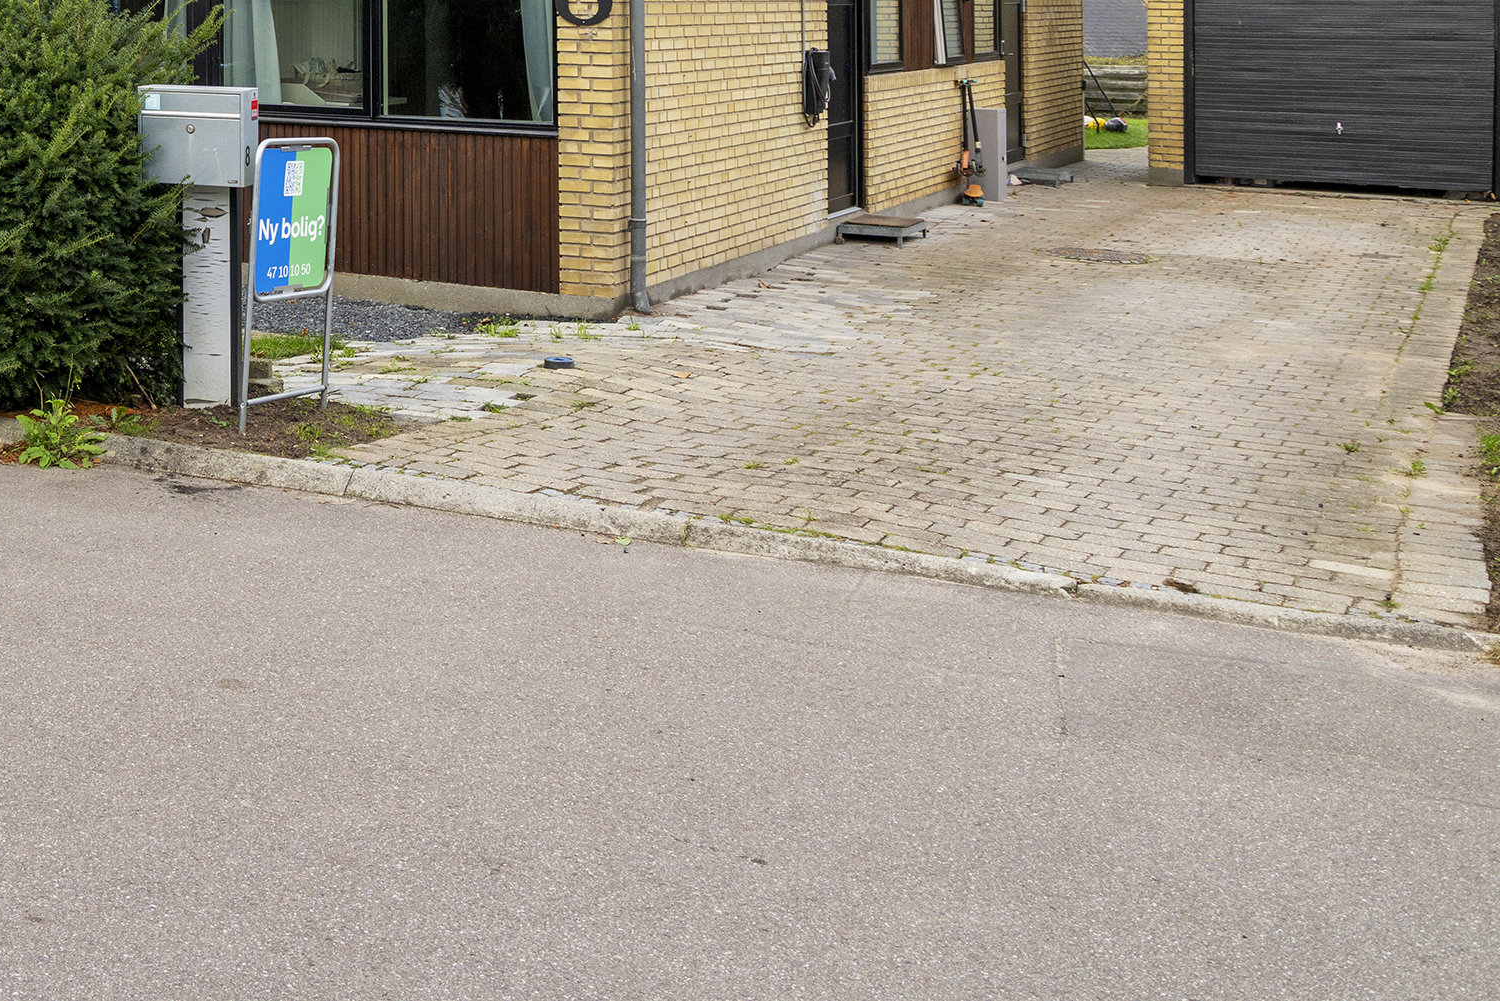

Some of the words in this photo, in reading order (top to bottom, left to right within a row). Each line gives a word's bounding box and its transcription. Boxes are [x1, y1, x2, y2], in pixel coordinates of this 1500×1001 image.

[245, 145, 251, 167] 8
[258, 218, 279, 246] Ny
[281, 214, 325, 242] bolig?
[266, 266, 278, 279] 47
[278, 265, 289, 278] 10
[290, 264, 300, 277] 10
[301, 263, 311, 276] 50
